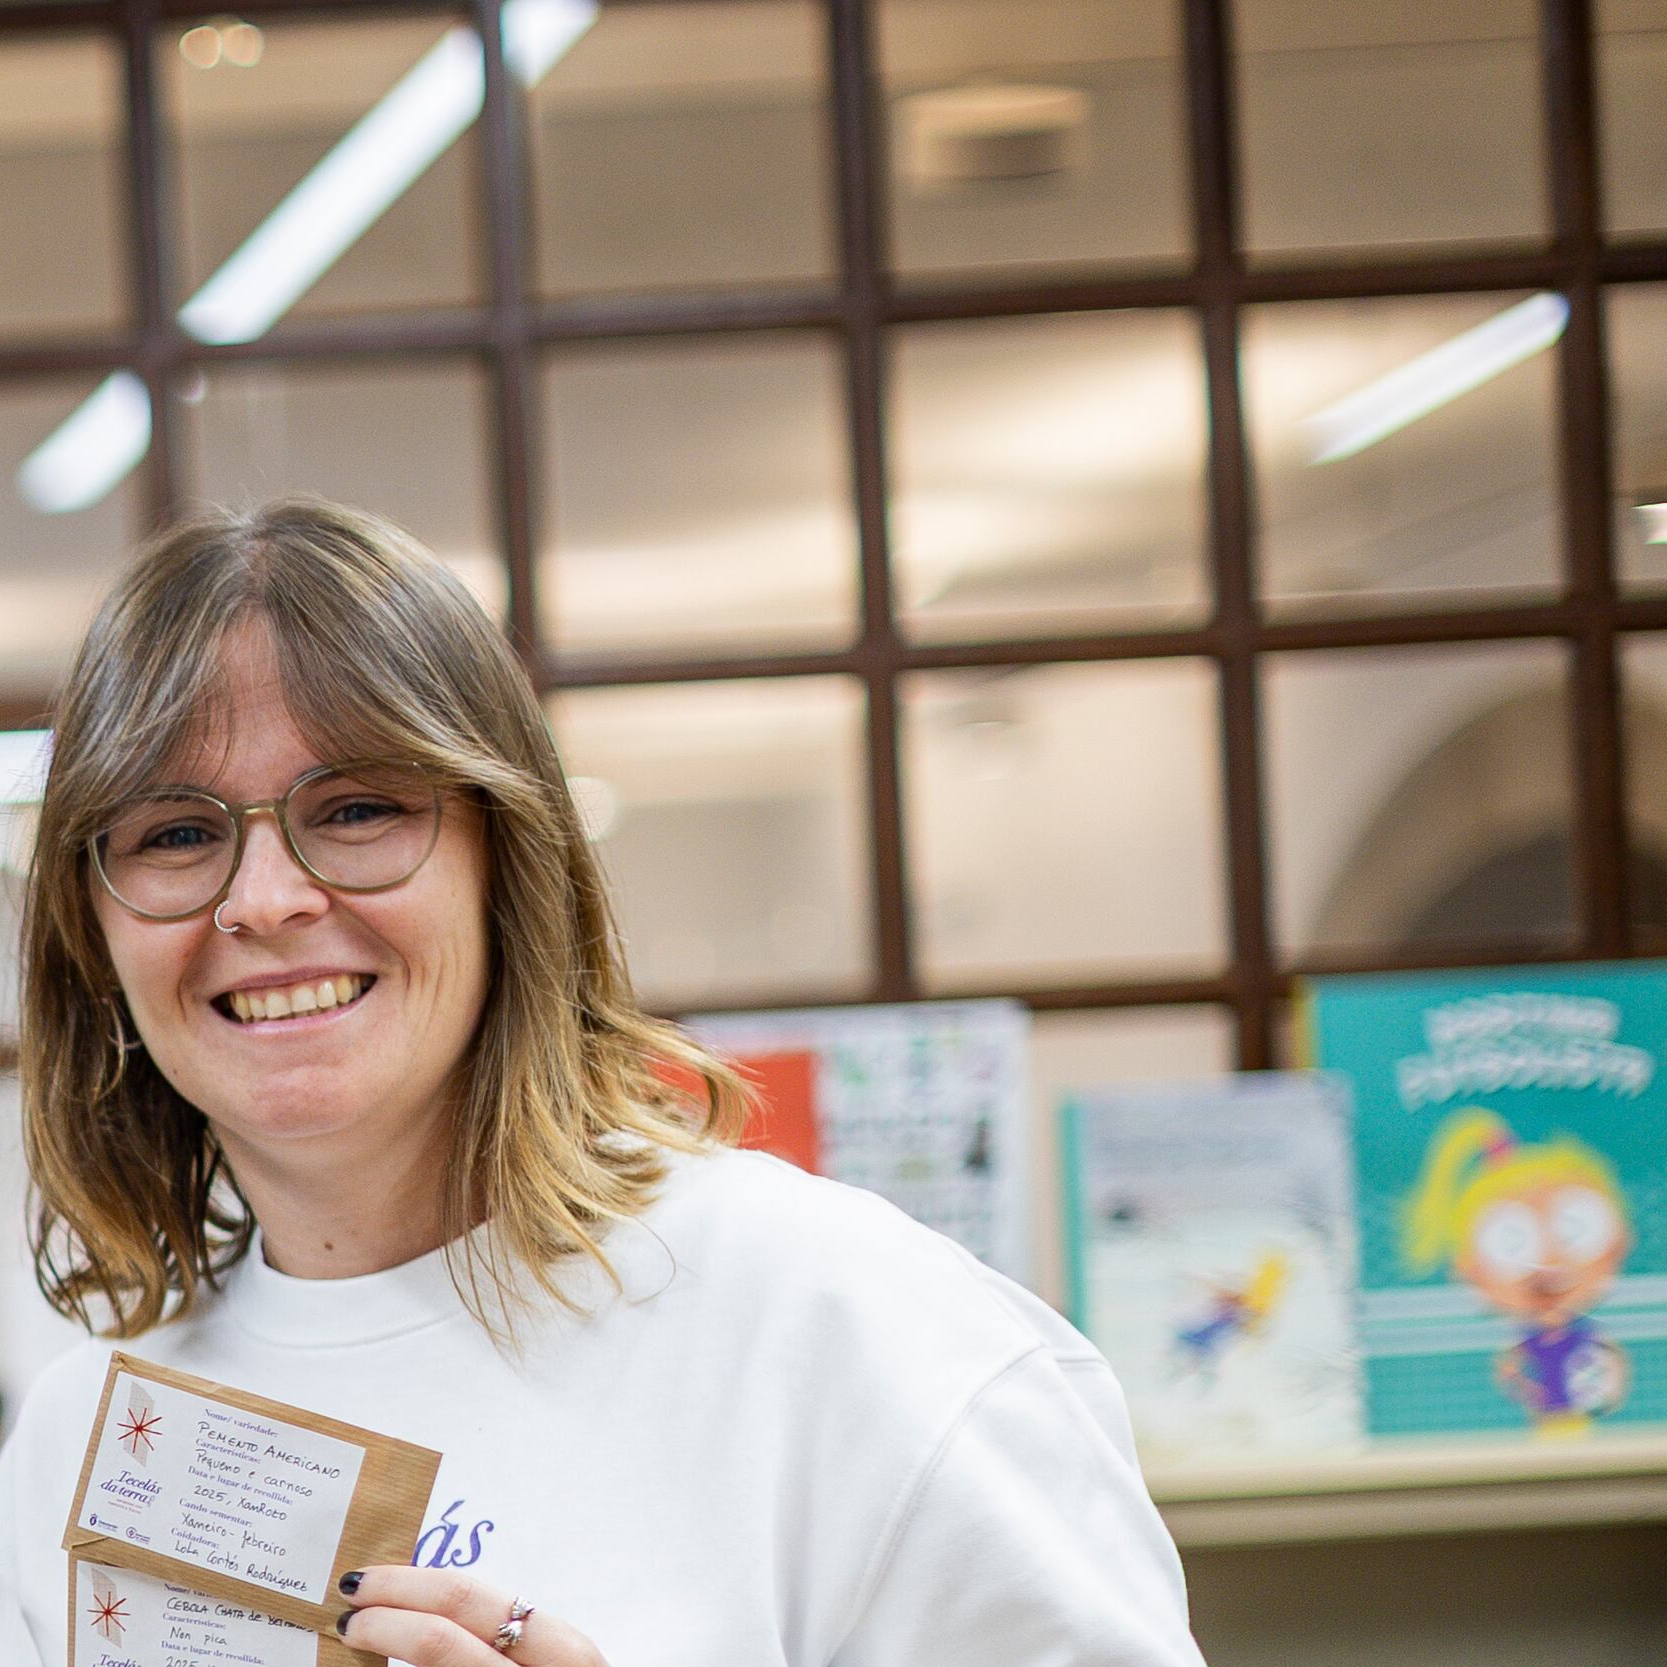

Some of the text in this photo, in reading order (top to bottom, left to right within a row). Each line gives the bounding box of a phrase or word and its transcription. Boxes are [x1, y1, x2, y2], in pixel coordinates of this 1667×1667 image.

[204, 1408, 279, 1439] Nome/ variedade:
[197, 1420, 341, 1479] PEMENTO AMERICANO
[117, 1469, 163, 1495] Tecelás
[187, 1465, 208, 1479] Data
[216, 1474, 241, 1488] lugar
[243, 1482, 252, 1491] de
[253, 1488, 293, 1506] recollida:
[195, 1448, 313, 1497] Pequeno e carnoso
[100, 1480, 149, 1503] da terra
[179, 1498, 253, 1528] Cando sementar:
[170, 1527, 220, 1549] Coidadora:
[240, 1529, 287, 1557] febreiro
[174, 1539, 199, 1557] Lola
[206, 1550, 239, 1572] Cortés
[166, 1596, 265, 1622] CEBOLA CHATA de
[161, 1640, 181, 1651] Data
[189, 1644, 212, 1656] lugar
[213, 1649, 224, 1657] de
[225, 1653, 265, 1666] recollida:
[203, 1632, 228, 1646] pica
